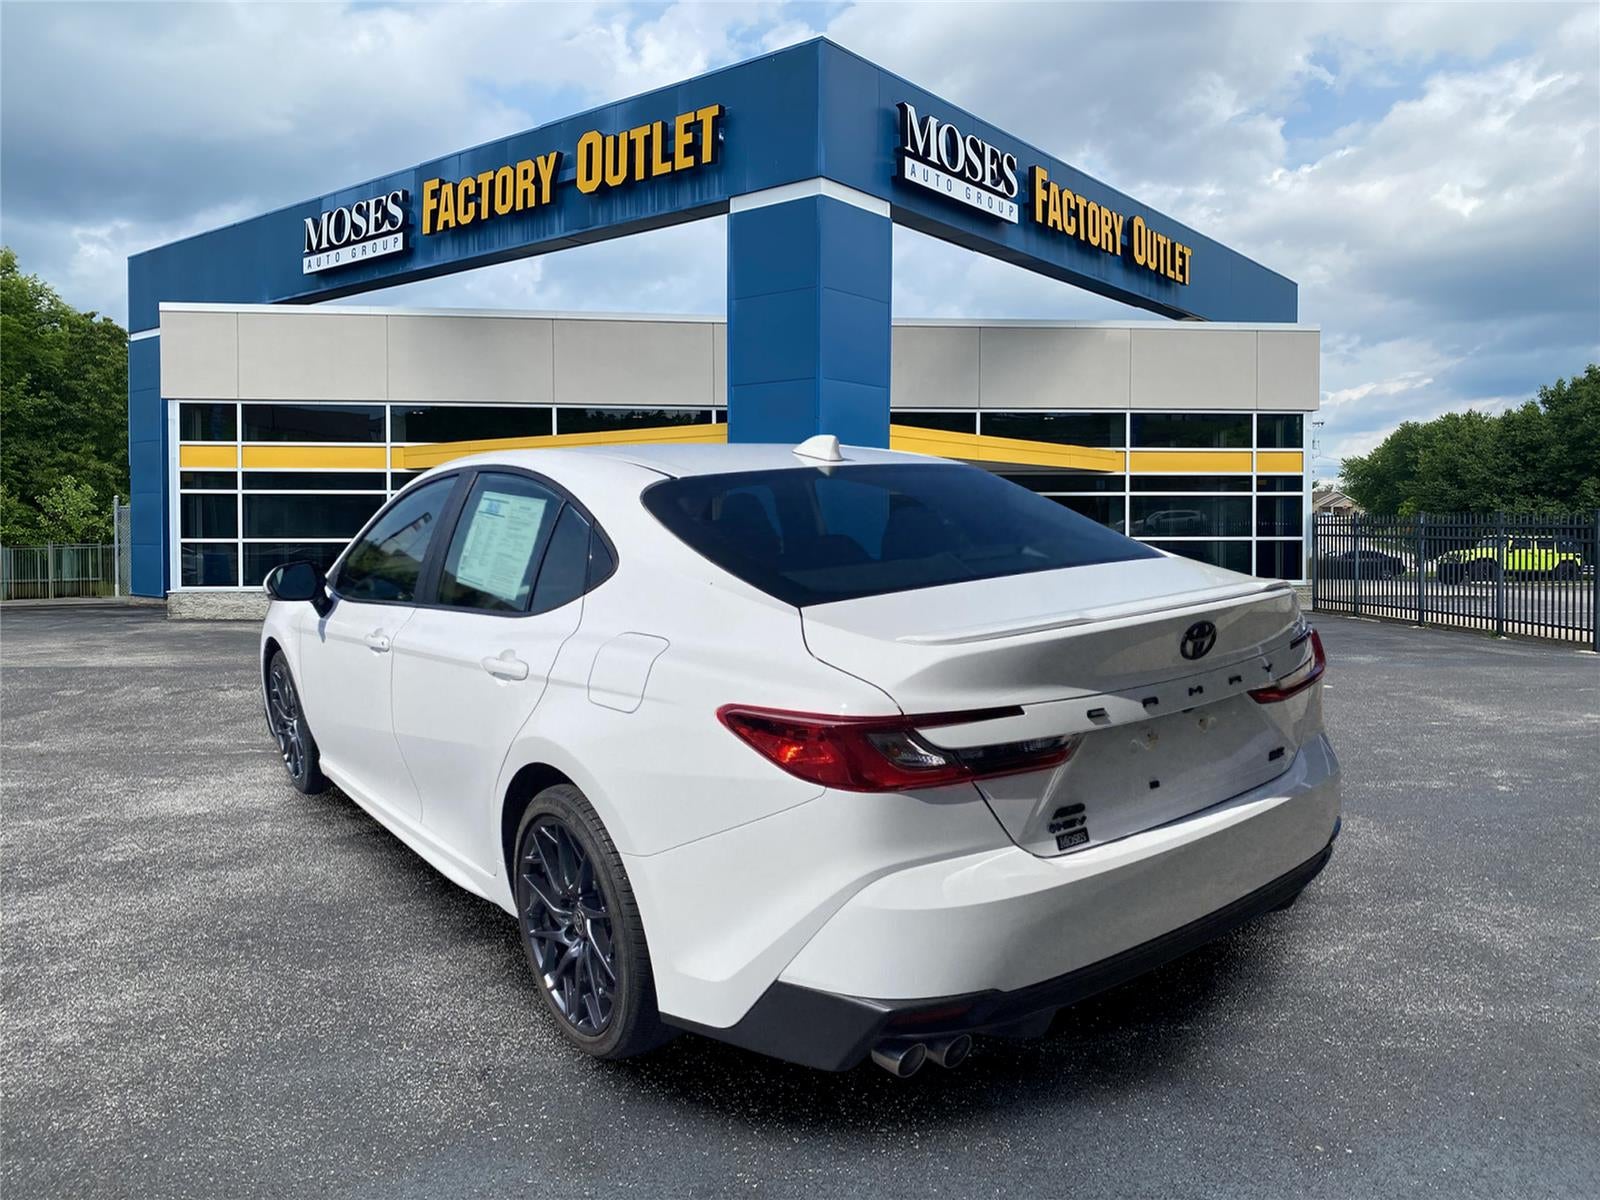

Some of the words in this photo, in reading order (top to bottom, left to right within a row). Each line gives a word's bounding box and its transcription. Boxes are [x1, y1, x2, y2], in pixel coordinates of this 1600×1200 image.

[422, 151, 559, 235] FACTORY
[576, 103, 721, 194] OUTLET
[904, 102, 1019, 198] MOSES
[303, 190, 404, 254] MOSES
[909, 163, 953, 193] AUTO
[965, 185, 1015, 218] GROUP
[1034, 165, 1125, 257] FACTORY
[1132, 215, 1193, 286] OUTLET
[307, 252, 341, 270] AUTO
[351, 237, 399, 259] GROUP
